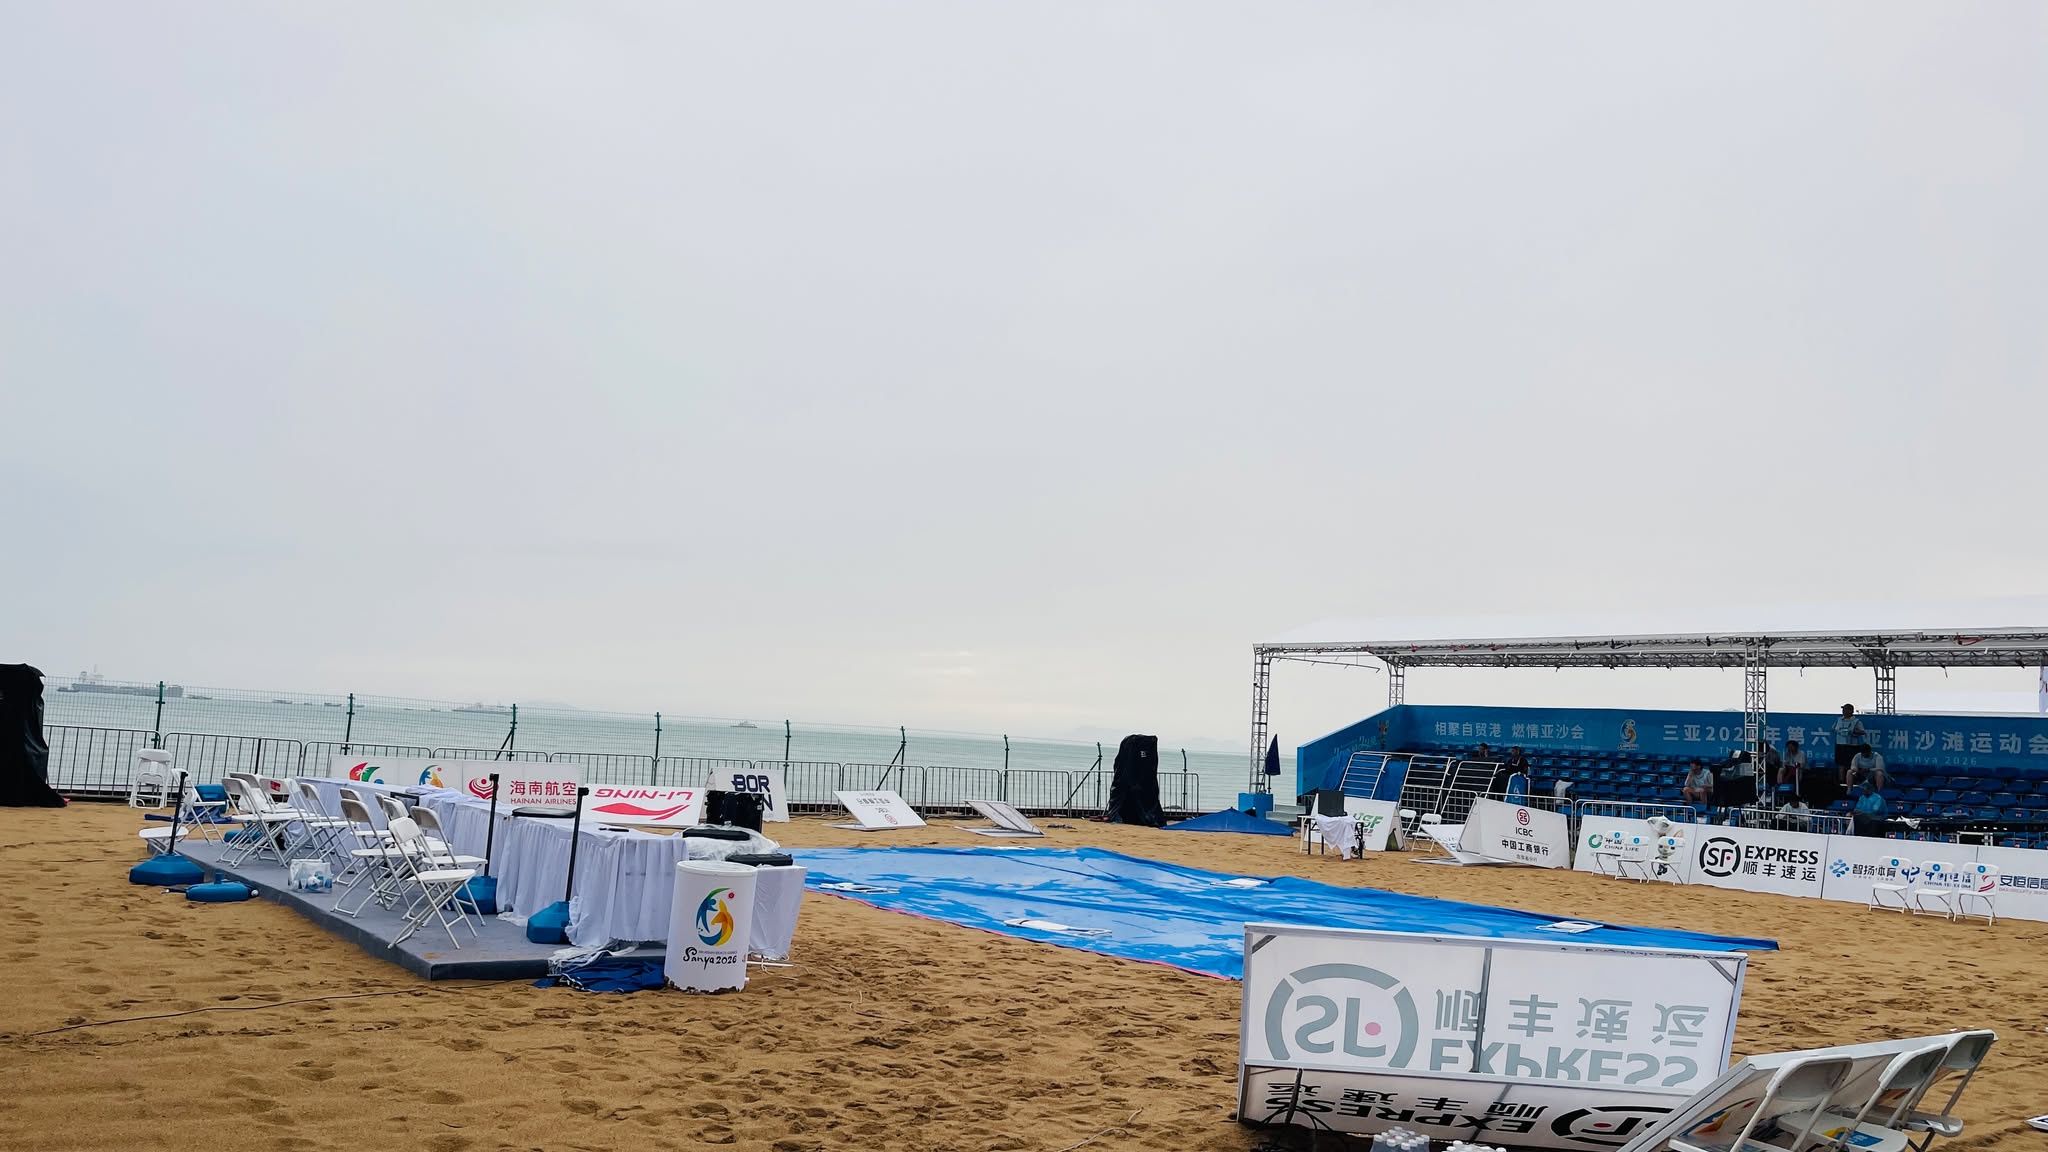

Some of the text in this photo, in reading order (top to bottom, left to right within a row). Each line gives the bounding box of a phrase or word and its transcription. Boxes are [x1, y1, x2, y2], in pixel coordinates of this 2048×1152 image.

[1435, 722, 1585, 740] 相聚自贸港 燃情亚沙会
[1945, 756, 1977, 766] 2026
[510, 780, 577, 797] 海南航空
[731, 774, 770, 793] BOR
[510, 797, 577, 806] HAINAN AIRLINES
[594, 788, 694, 801] LI-NING
[1515, 826, 1534, 838] ICBC
[1501, 839, 1549, 856] 中国工商银行
[1744, 845, 1819, 865] EXPRESS
[1706, 847, 1734, 868] SF
[1742, 861, 1817, 882] 顺丰速运
[683, 946, 738, 971] Sanya 2026
